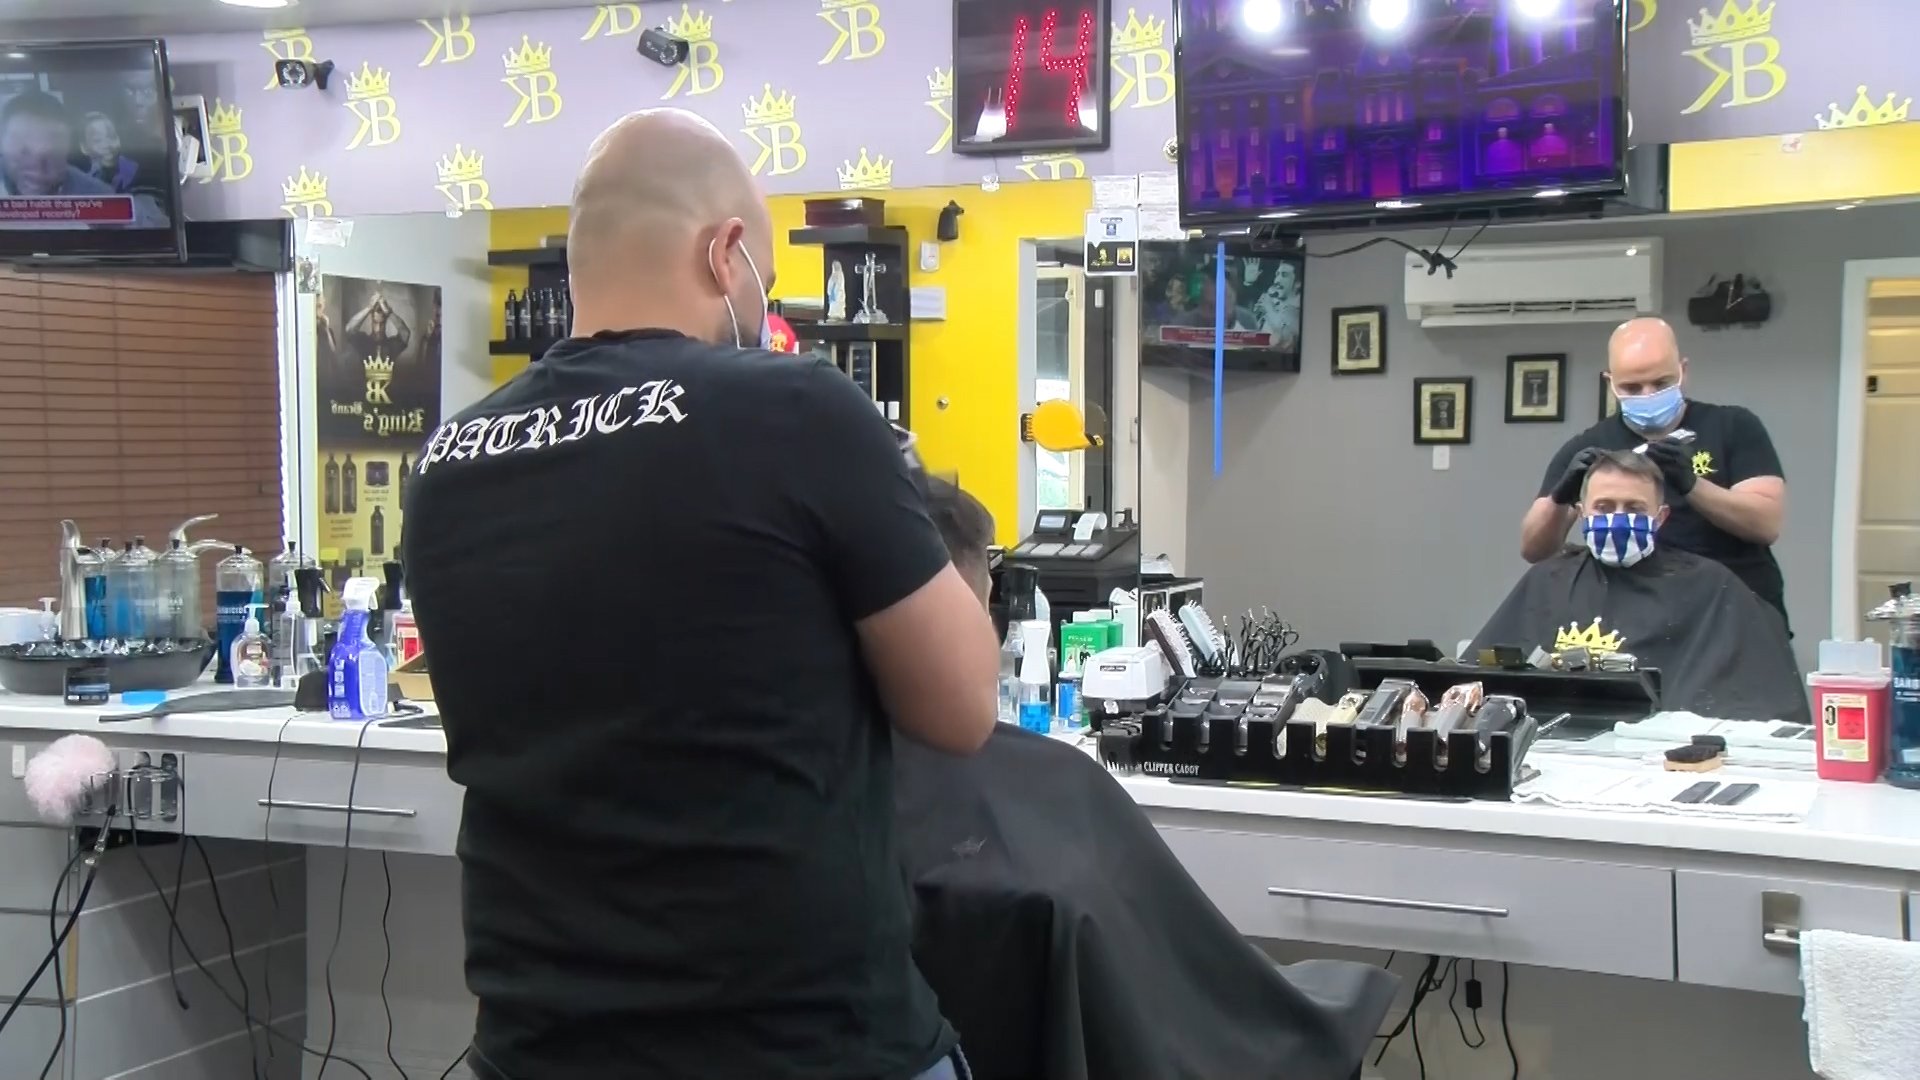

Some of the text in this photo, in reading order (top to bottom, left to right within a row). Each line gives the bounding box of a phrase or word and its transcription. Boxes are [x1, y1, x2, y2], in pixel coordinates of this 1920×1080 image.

[1004, 9, 1093, 128] 14
[417, 379, 689, 476] PATRICK
[1143, 761, 1200, 776] CLIPPER CADDY
